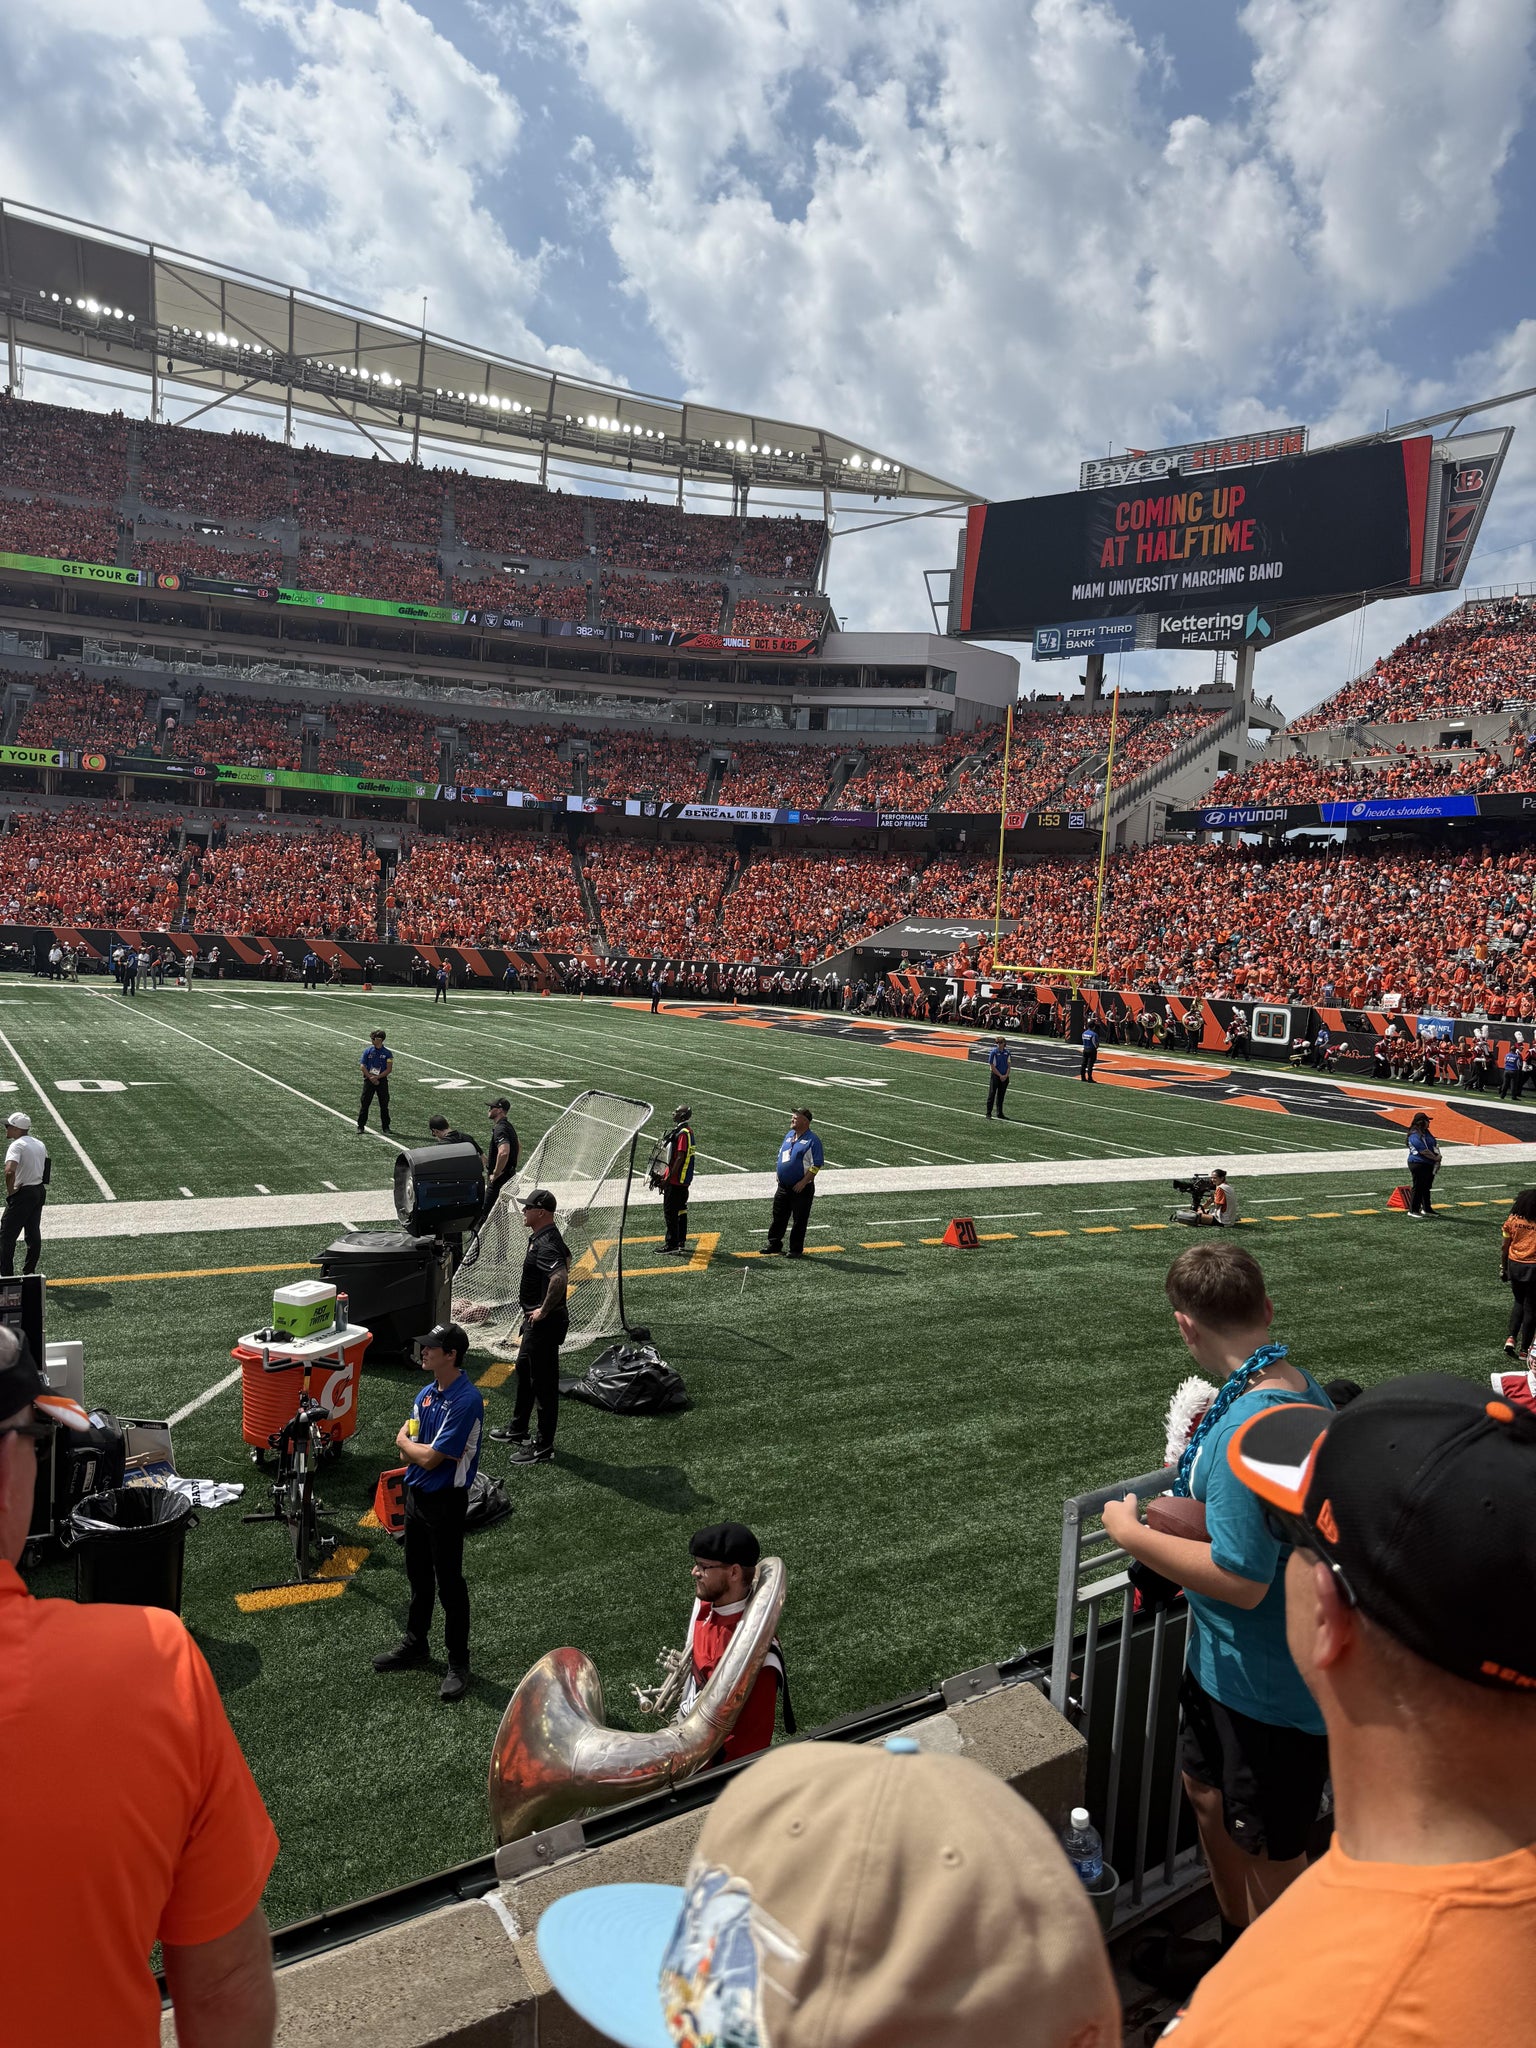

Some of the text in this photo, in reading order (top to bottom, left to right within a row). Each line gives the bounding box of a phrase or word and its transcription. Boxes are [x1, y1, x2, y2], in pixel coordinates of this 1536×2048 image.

[1081, 434, 1302, 484] Paycor STADIUM
[1115, 485, 1246, 532] COMING UP
[1100, 519, 1257, 568] AT HALFTIME
[61, 564, 84, 575] GET
[88, 567, 122, 580] YOUR
[1072, 561, 1283, 600] MIAMI UNIVERSITY MARCHING BAND
[470, 614, 523, 628] 4 SMITH
[1160, 612, 1244, 633] Kettering
[1066, 624, 1133, 639] FIFTH THIRD
[1181, 629, 1231, 644] HEALTH
[722, 637, 751, 648] JUNGLE
[754, 640, 770, 649] OCT.
[772, 640, 778, 650] 5
[780, 641, 798, 651] 4:25
[1065, 639, 1095, 649] BANK
[9, 751, 47, 763] YOUR
[685, 809, 771, 820] BENGAL OCT. 16 8:15
[1038, 814, 1083, 826] 1:53 25
[1228, 809, 1288, 823] HYUNDAI
[903, 820, 927, 828] REFUSE
[1257, 1013, 1283, 1038] 25
[418, 1078, 566, 1089] 20
[779, 1077, 889, 1087] 10
[955, 1220, 978, 1245] 20
